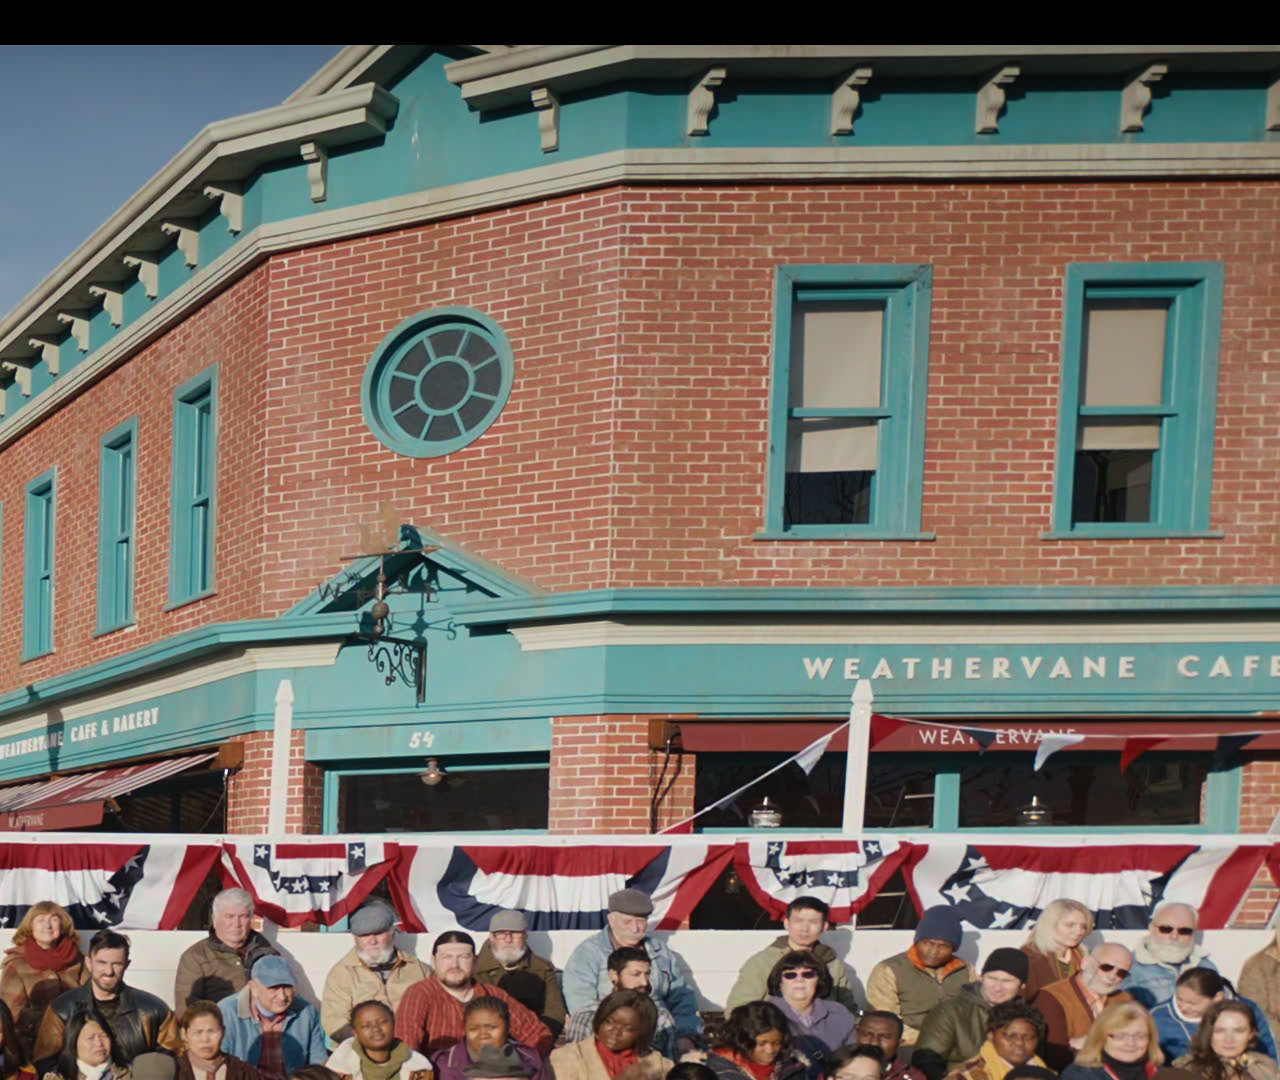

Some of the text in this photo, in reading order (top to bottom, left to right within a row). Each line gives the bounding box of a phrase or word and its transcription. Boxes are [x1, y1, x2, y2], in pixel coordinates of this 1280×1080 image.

[802, 655, 1280, 680] WEATHERVANE CAFE
[70, 721, 98, 743] CAFE
[101, 719, 110, 736] &
[113, 707, 159, 733] BAKERY
[408, 731, 435, 749] 54
